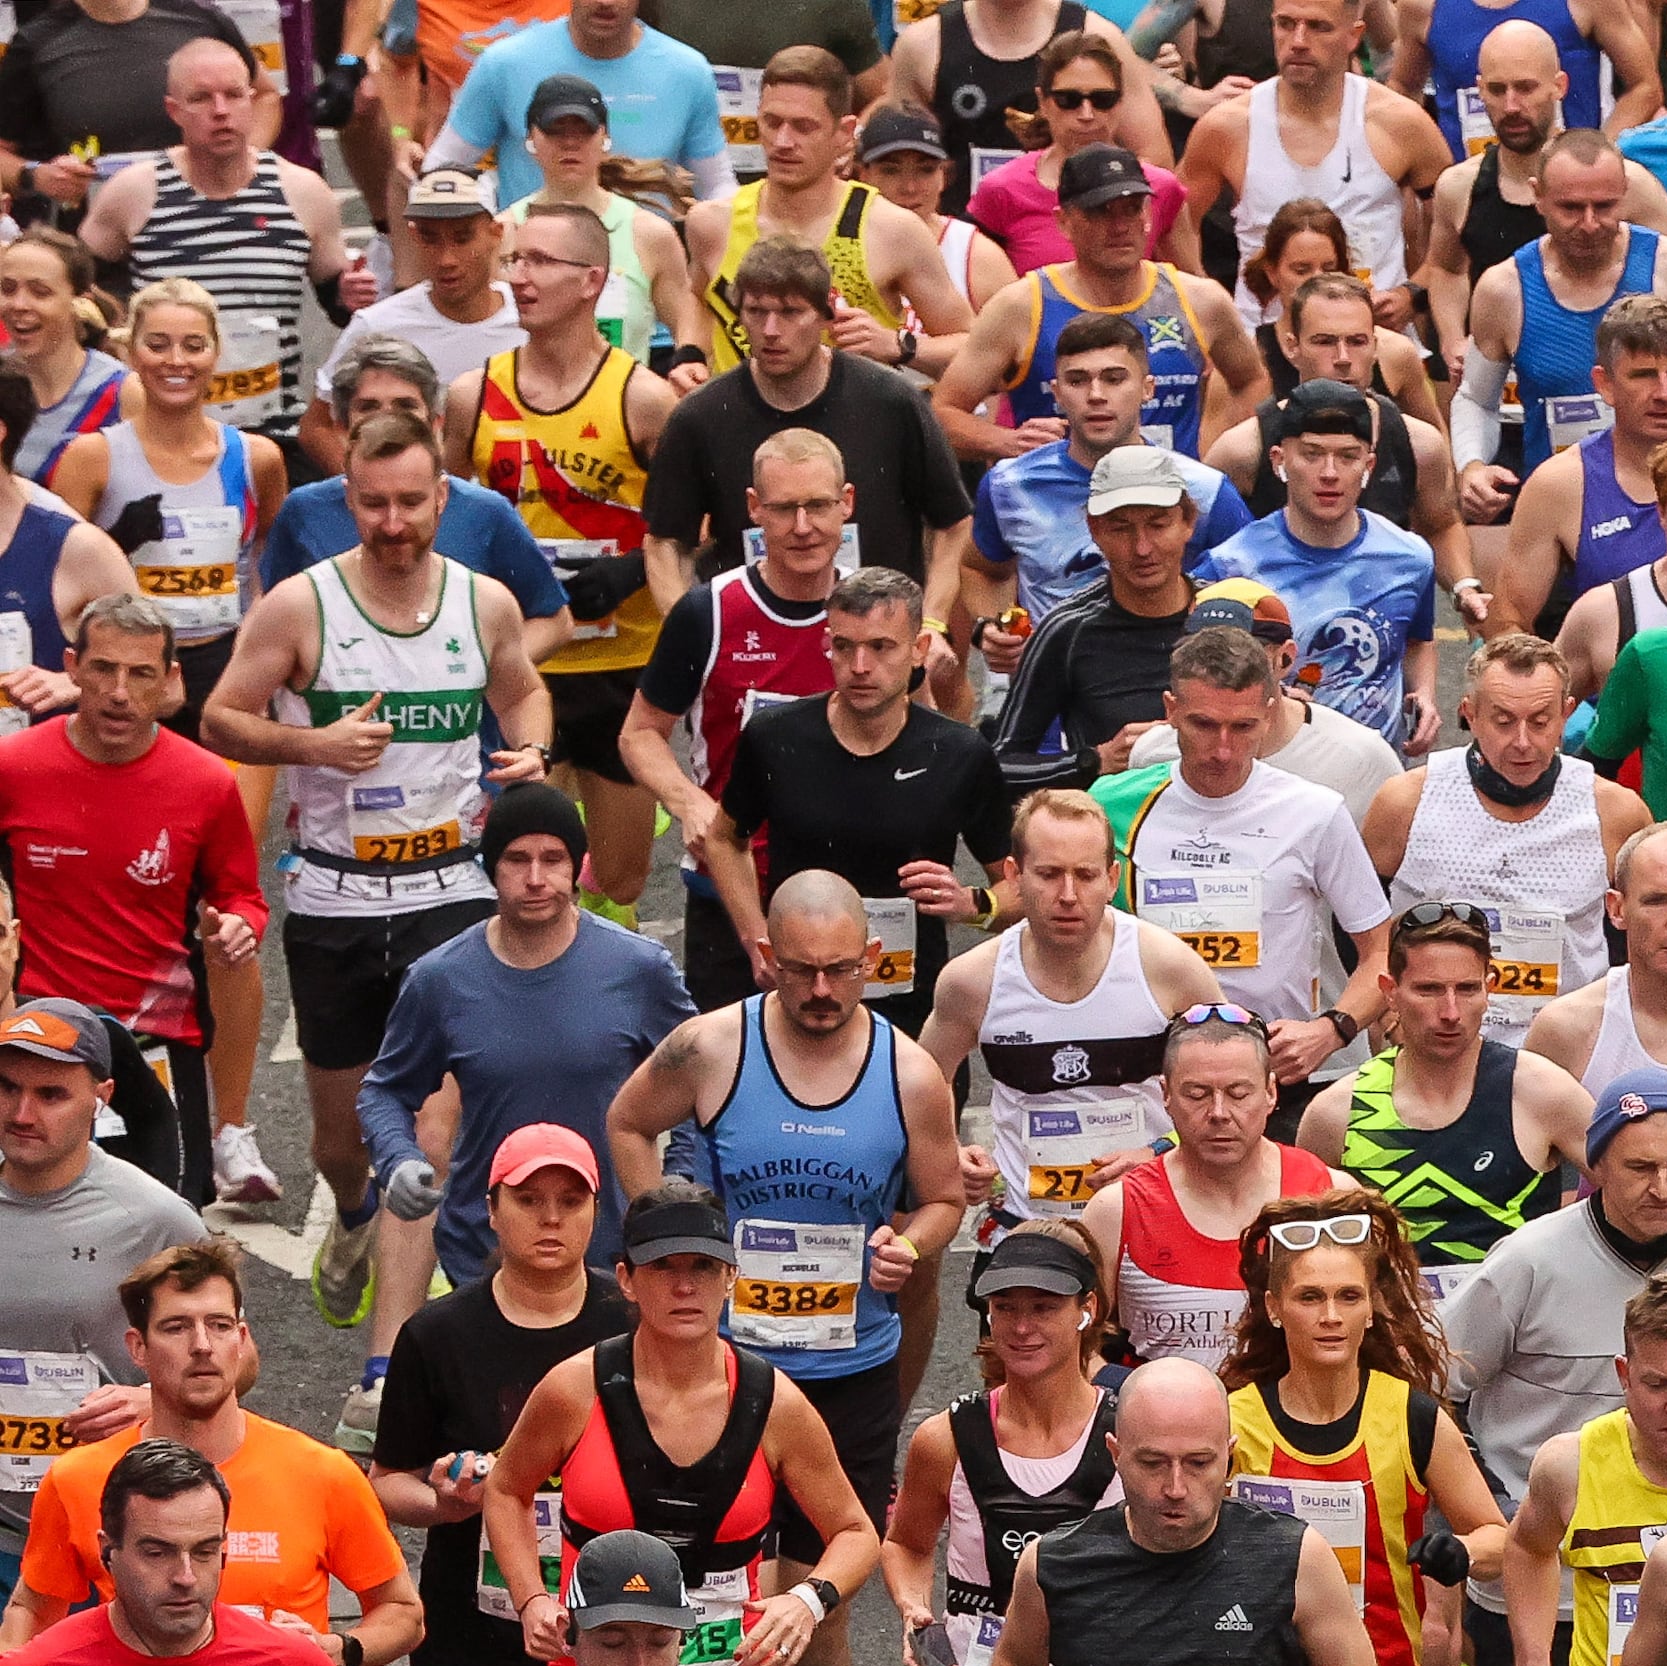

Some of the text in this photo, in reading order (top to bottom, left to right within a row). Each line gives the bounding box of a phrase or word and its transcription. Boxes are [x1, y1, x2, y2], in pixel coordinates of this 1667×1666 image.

[1590, 517, 1632, 539] HOKA
[341, 700, 471, 733] HENY
[367, 826, 450, 863] 2783
[1170, 847, 1230, 865] KILCOOLE AC
[1507, 916, 1553, 931] DUBLIN
[726, 1156, 873, 1193] BALBRIGGAN
[737, 1183, 829, 1212] DISTRICT
[747, 1283, 841, 1314] 3386
[34, 1364, 85, 1382] DUBLIN
[1214, 1621, 1254, 1632] adidas
